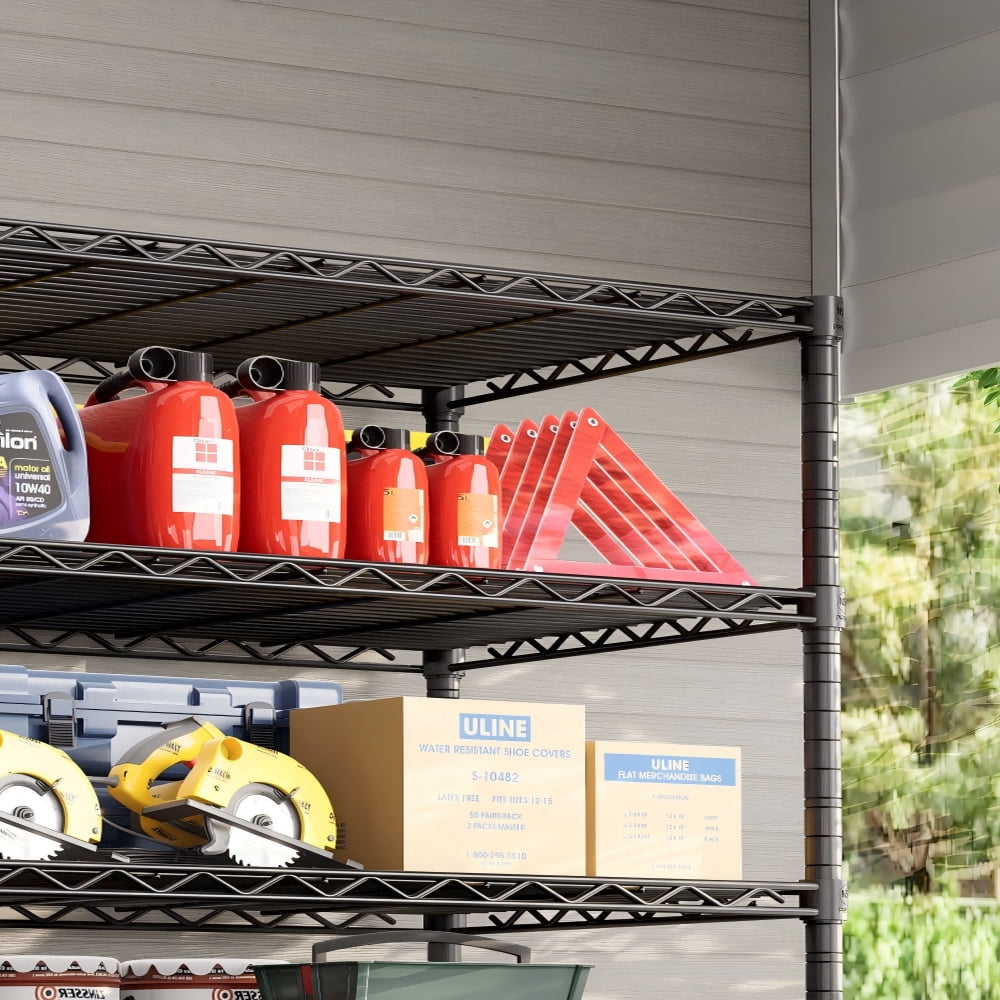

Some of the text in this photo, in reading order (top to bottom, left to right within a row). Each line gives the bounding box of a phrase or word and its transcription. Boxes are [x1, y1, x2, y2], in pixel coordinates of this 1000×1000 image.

[41, 465, 50, 473] oil
[15, 482, 51, 495] 10W40
[463, 717, 527, 738] ULINE
[419, 744, 571, 759] WATER RESISTANT SHOE COVERS
[651, 759, 689, 771] ULINE
[472, 771, 519, 782] S-10482
[618, 770, 636, 779] FLAT
[700, 774, 722, 783] BAGS
